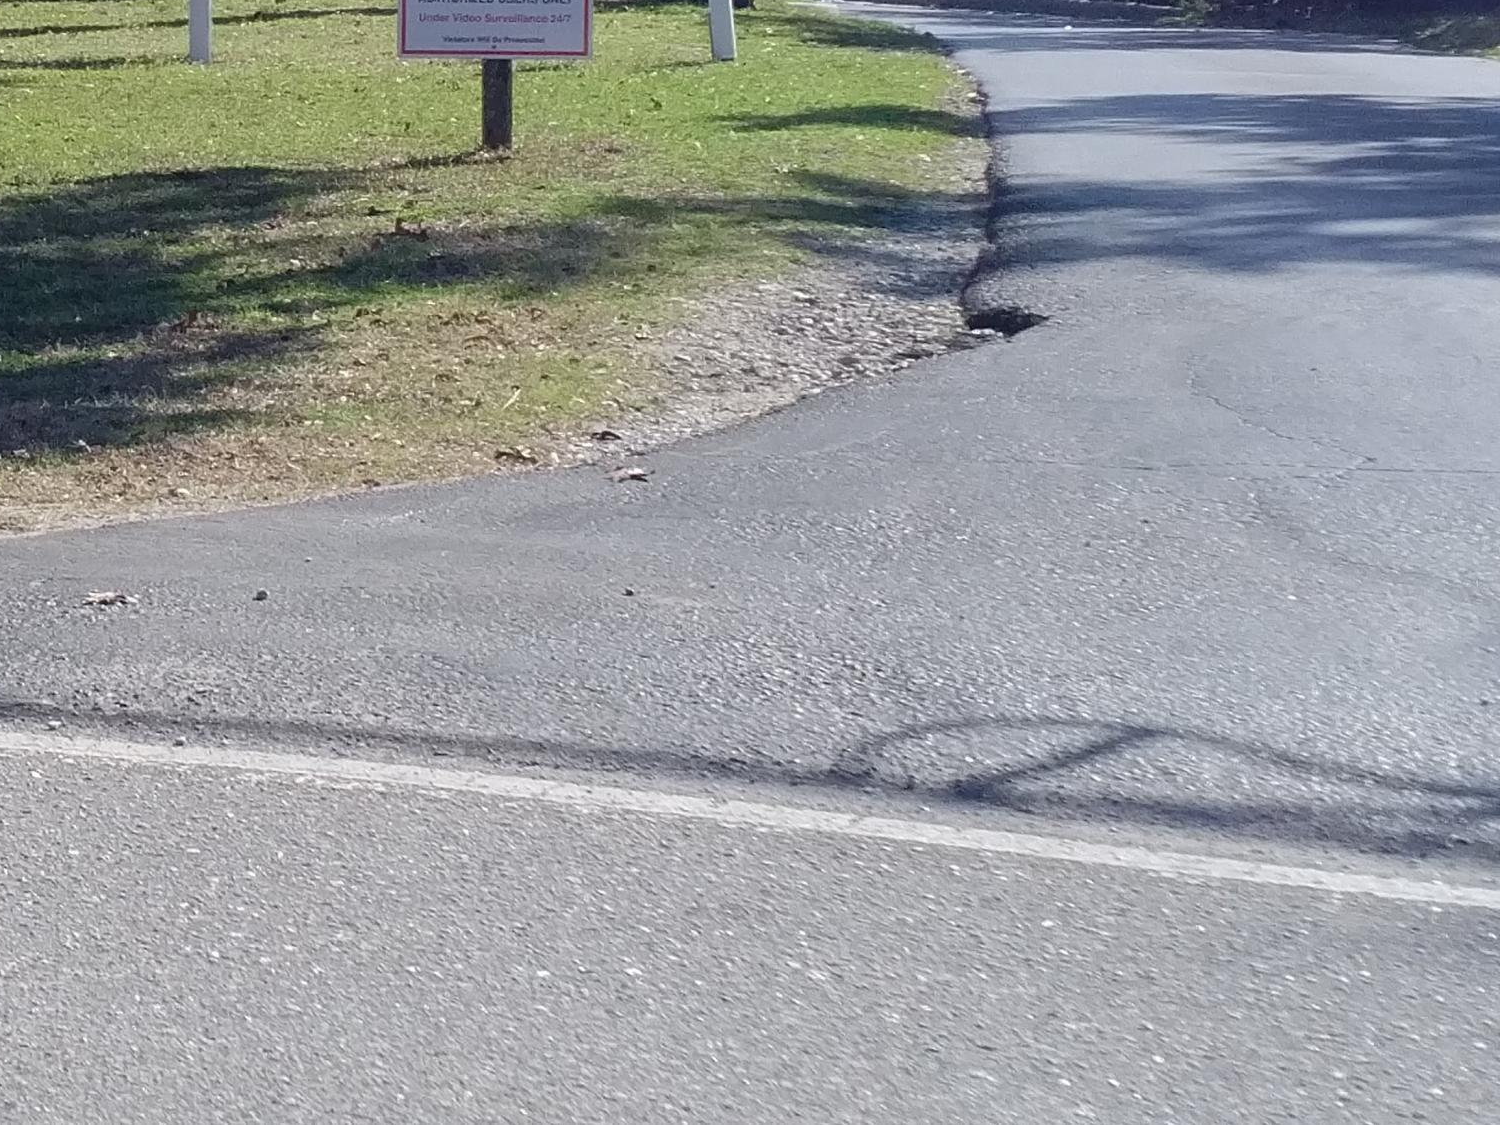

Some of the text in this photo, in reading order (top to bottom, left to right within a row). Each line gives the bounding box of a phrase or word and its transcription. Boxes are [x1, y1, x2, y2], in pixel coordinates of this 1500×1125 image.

[419, 13, 572, 23] Under Video Surveillance 24/7
